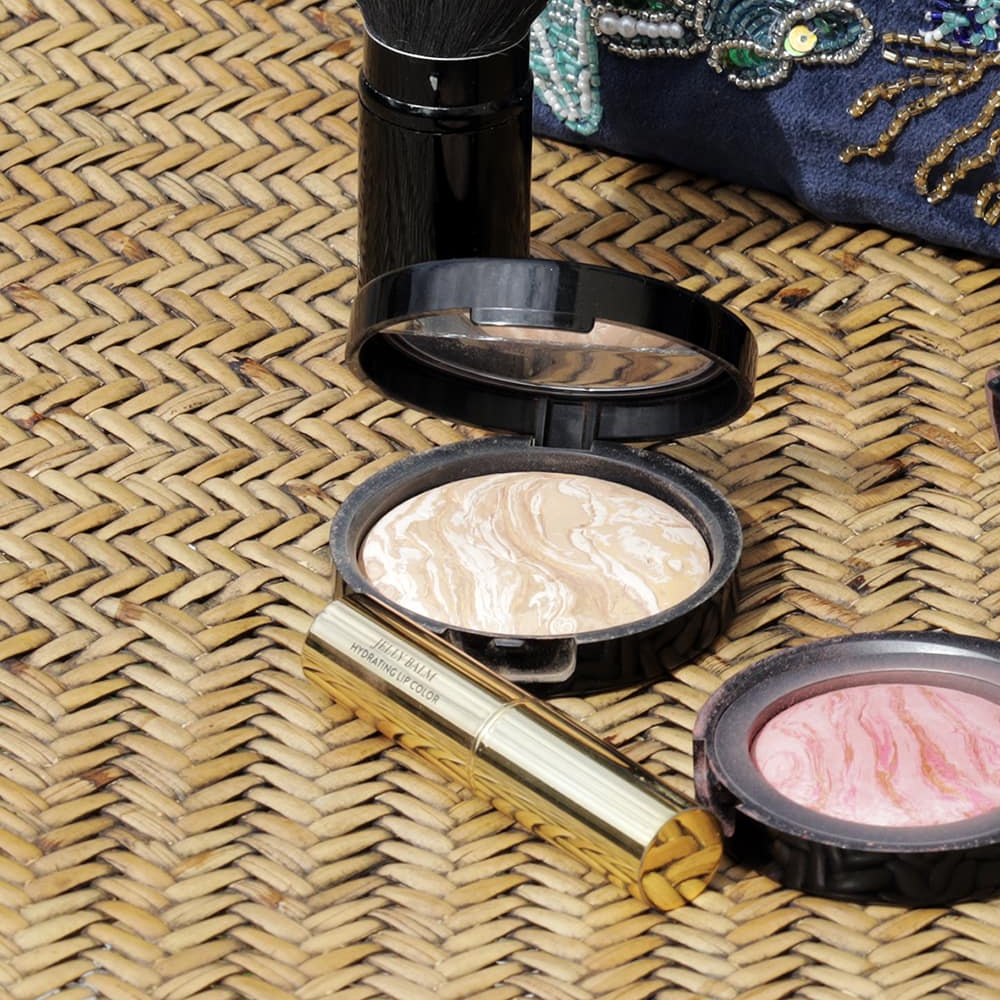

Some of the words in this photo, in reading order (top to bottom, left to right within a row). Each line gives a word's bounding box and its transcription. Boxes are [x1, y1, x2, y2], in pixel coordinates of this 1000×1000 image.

[350, 642, 397, 678] HYDRATING
[396, 671, 411, 686] LIP
[410, 680, 441, 705] COLOR
[371, 638, 405, 662] JELLY
[404, 656, 438, 682] BALM
